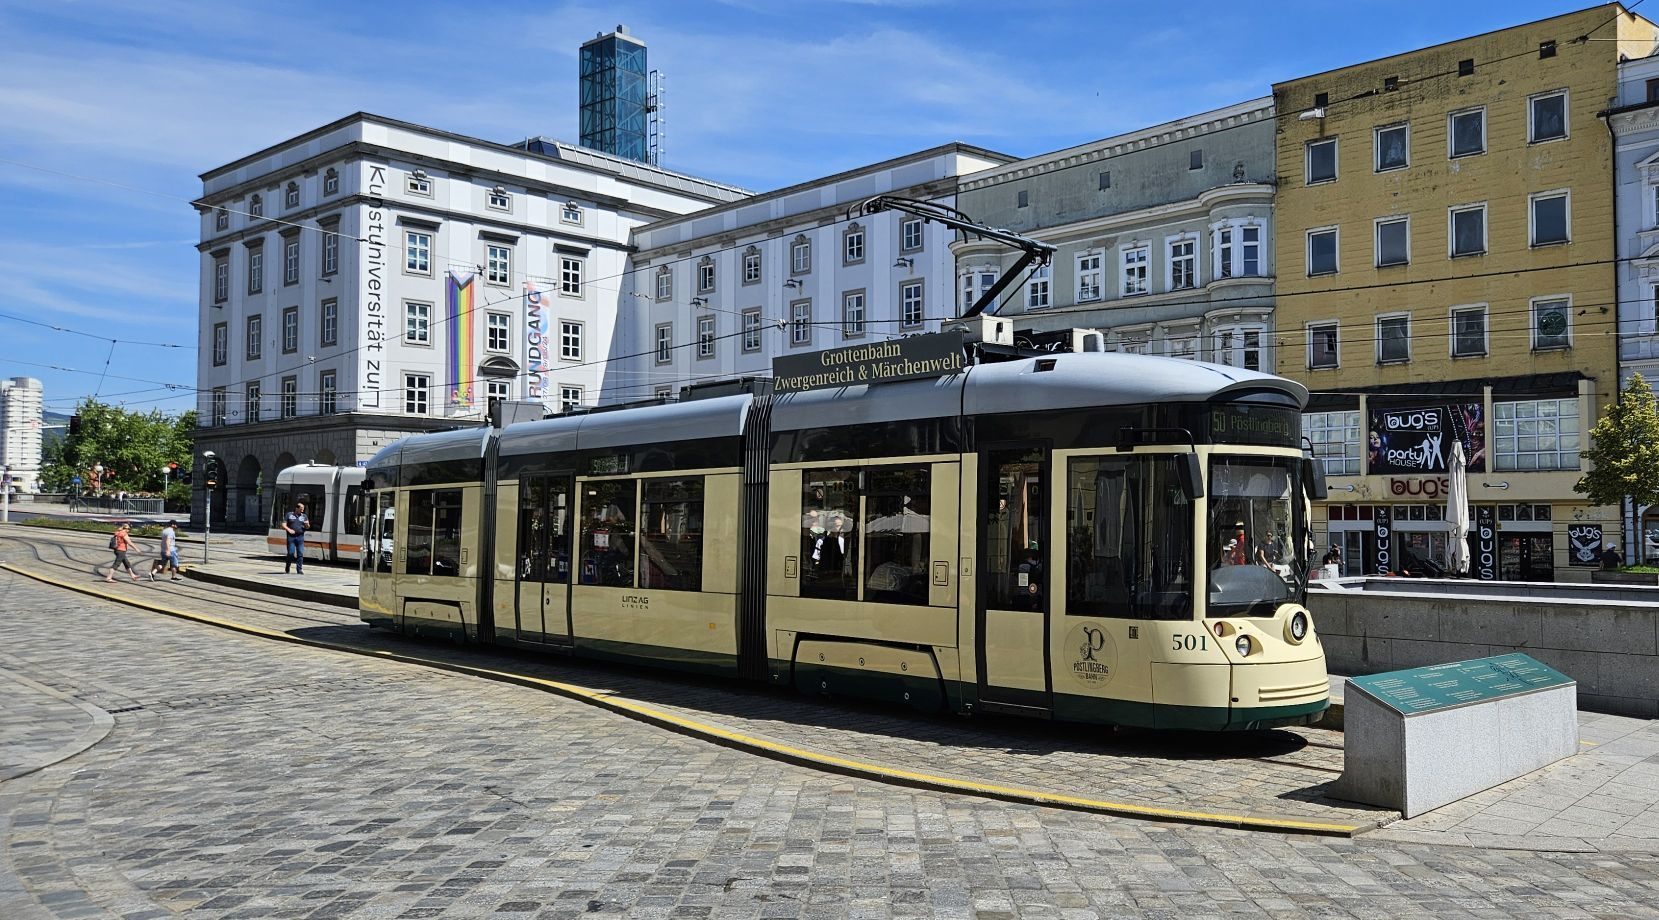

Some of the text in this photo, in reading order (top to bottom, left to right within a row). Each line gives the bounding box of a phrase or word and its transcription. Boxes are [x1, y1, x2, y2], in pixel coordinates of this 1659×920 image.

[367, 165, 386, 352] Kunstuniversität
[527, 290, 542, 399] RUNDGANG
[821, 342, 901, 366] Grottenbahn
[774, 352, 962, 390] Zwergenreich & Märchenwelt
[1213, 411, 1226, 432] 50
[1387, 411, 1438, 429] bug's
[1388, 447, 1423, 464] party
[1389, 459, 1417, 468] HOUSE
[1390, 477, 1449, 499] bug's
[1568, 526, 1602, 540] bug's
[1172, 634, 1208, 651] 501
